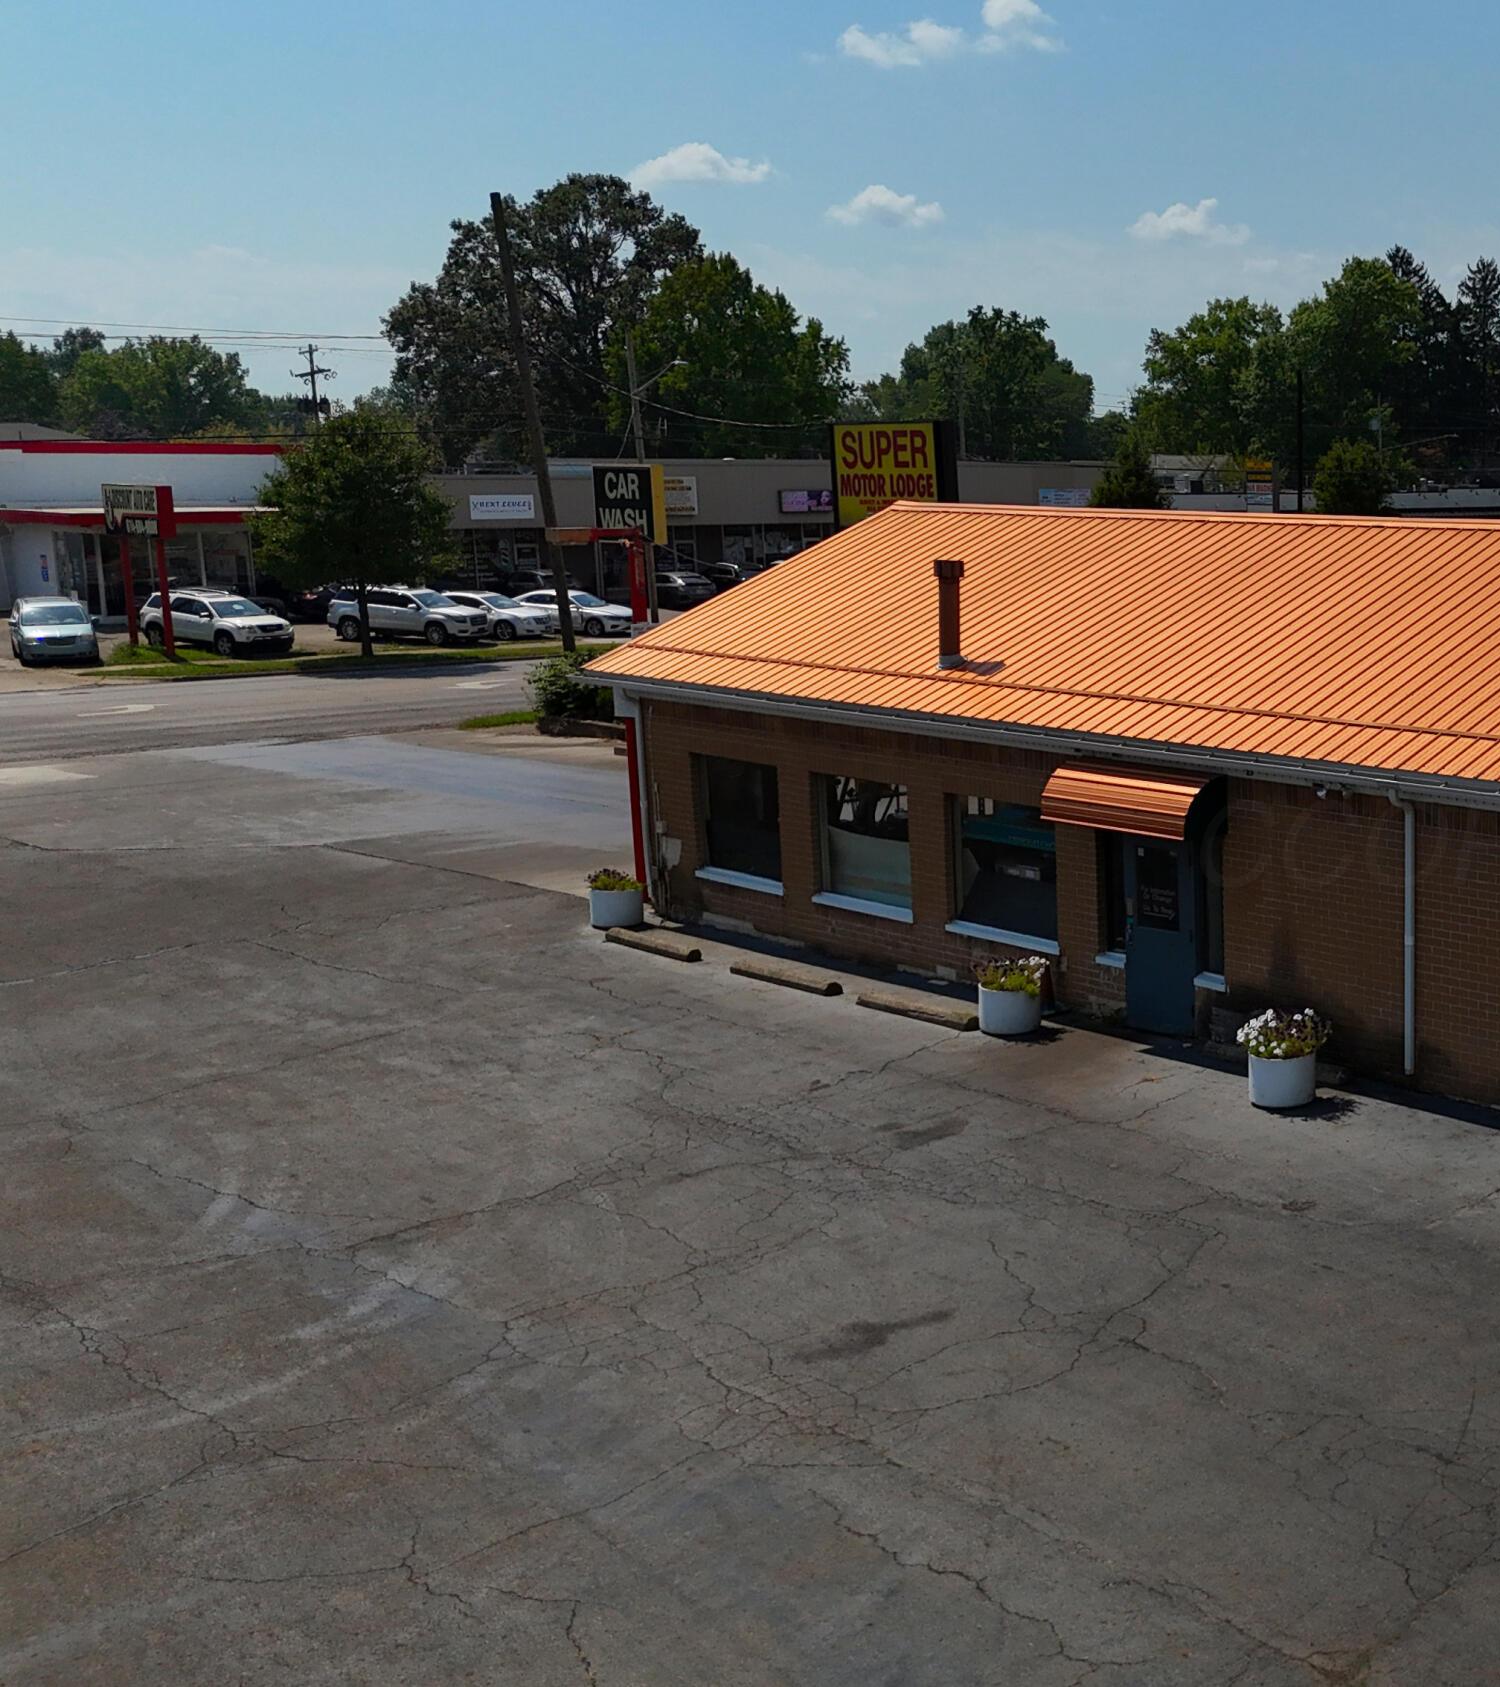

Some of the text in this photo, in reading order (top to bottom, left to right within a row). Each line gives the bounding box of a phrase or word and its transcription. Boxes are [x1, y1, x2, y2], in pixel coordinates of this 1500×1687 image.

[841, 429, 928, 470] SUPER
[604, 471, 640, 501] CAR
[840, 473, 935, 499] MOTOR LODGE
[598, 507, 648, 537] WASH
